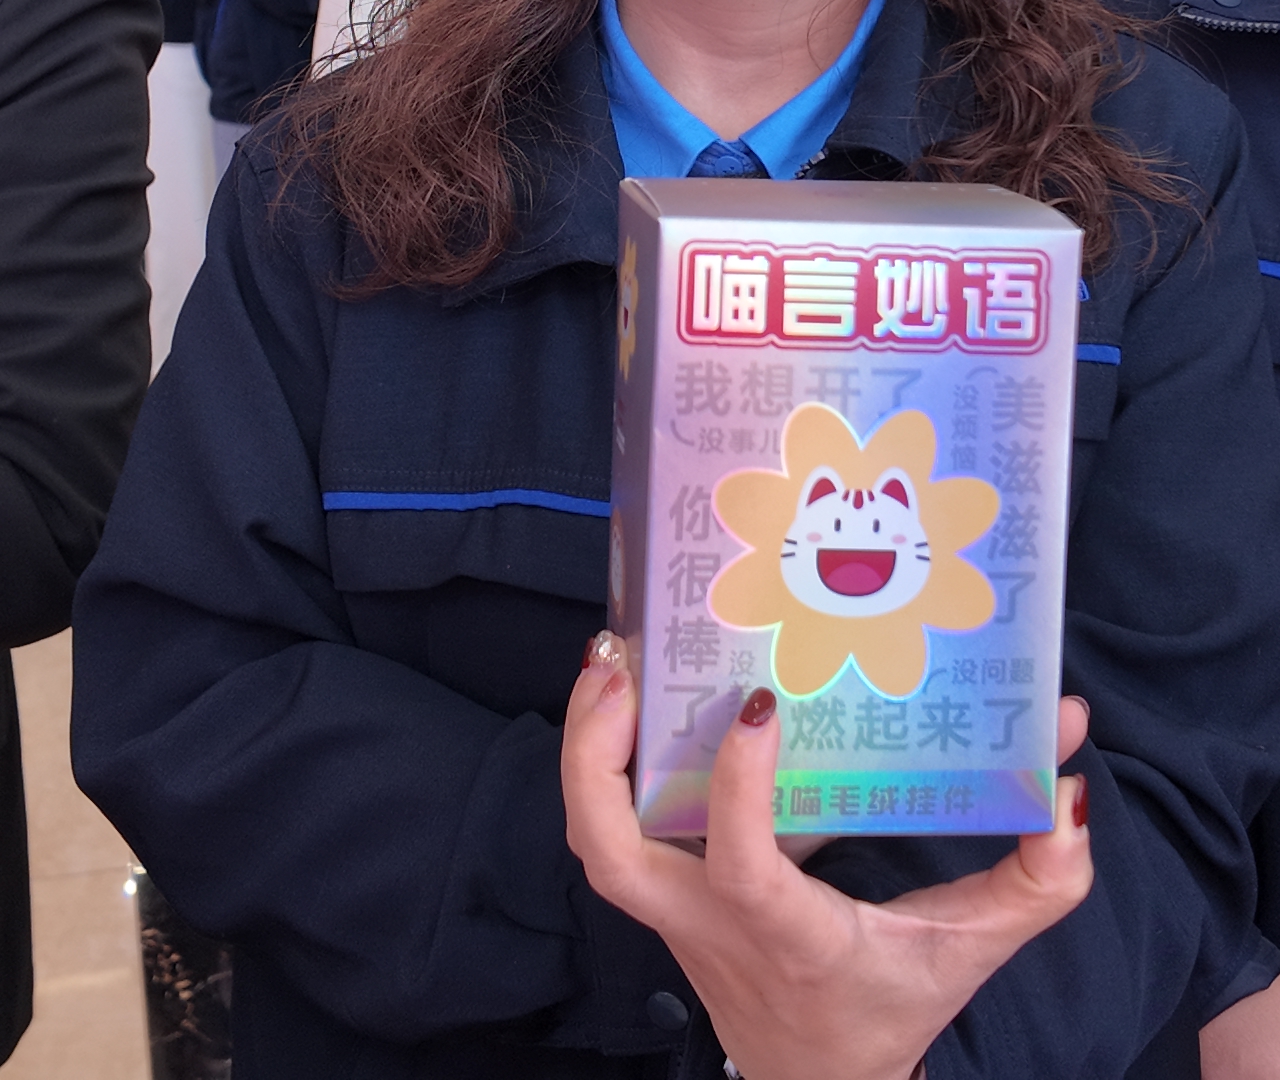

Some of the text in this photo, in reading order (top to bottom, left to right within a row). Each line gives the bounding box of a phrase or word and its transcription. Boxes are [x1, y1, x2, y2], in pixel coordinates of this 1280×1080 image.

[693, 255, 1037, 339] 喵言妙语
[674, 360, 923, 418] 我想开了
[987, 375, 1045, 624] 美滋滋了
[662, 484, 724, 738] 你很棒了
[951, 657, 1036, 686] 没问题
[788, 696, 1033, 752] 燃起来了
